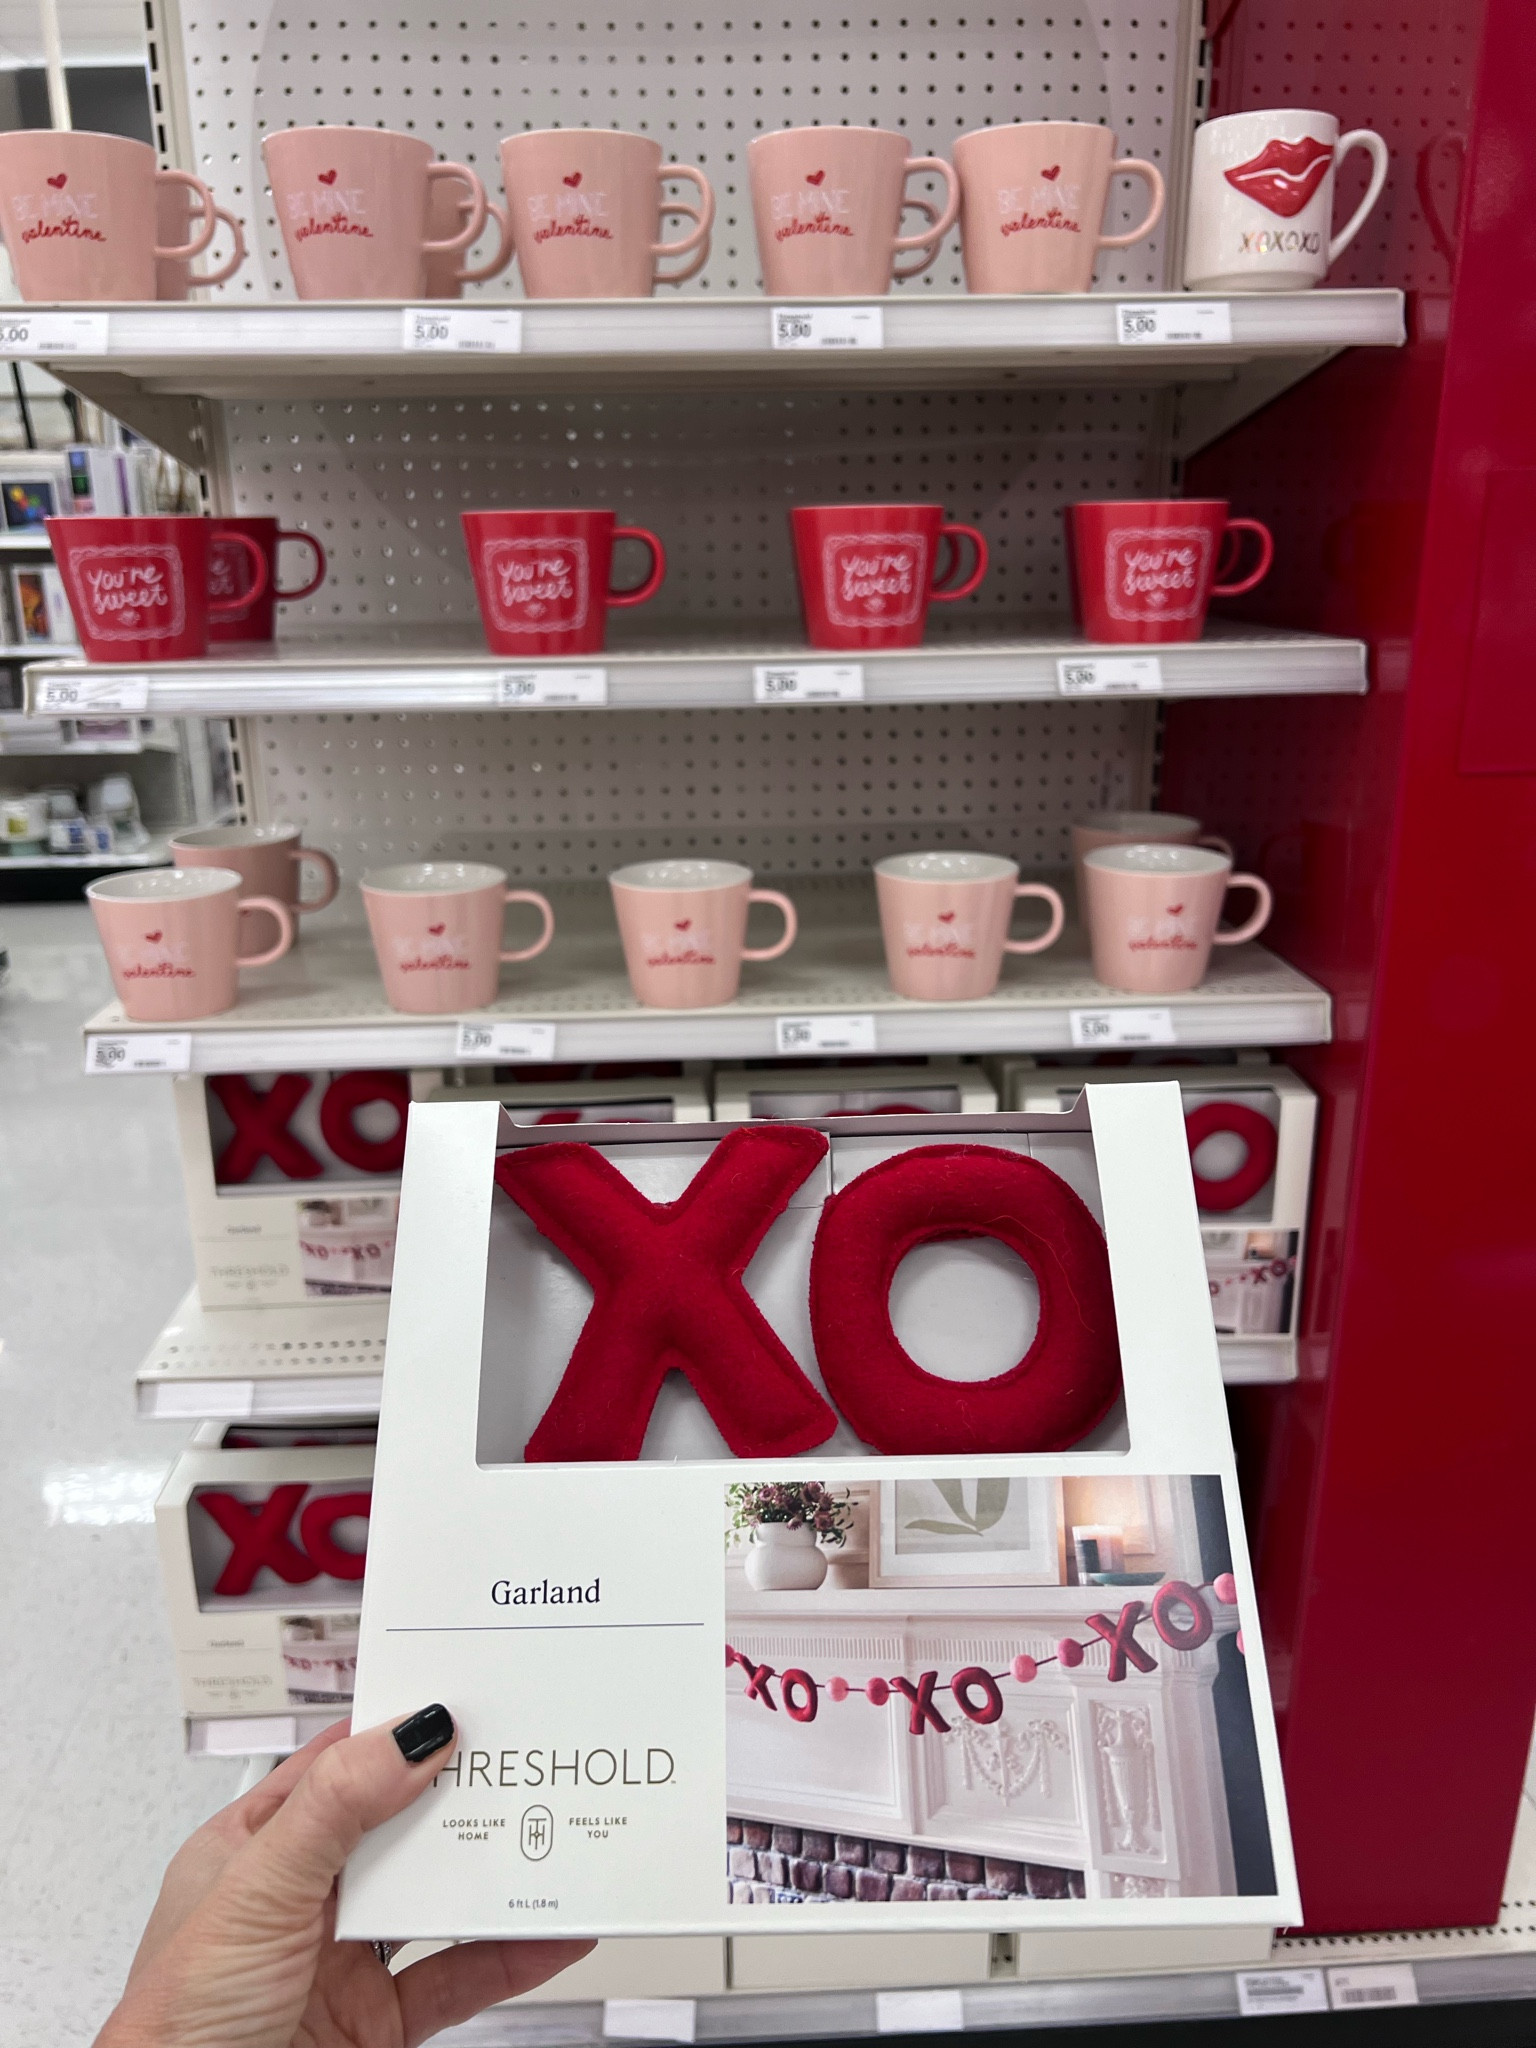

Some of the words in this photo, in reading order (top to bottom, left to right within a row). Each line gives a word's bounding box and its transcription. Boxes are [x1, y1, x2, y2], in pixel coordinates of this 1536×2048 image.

[1237, 230, 1321, 255] XOXOXO
[414, 325, 449, 339] 5.00
[778, 323, 812, 338] 5.00
[1124, 319, 1156, 333] 5.00
[494, 1125, 1123, 1463] XO
[490, 1577, 602, 1606] Garland
[890, 1666, 1004, 1735] XO
[1084, 1580, 1213, 1682] XO
[432, 1747, 675, 1788] HRESHOLD
[442, 1818, 479, 1829] LOOKS
[482, 1818, 507, 1828] LIKE
[568, 1817, 601, 1827] FEELS
[603, 1816, 629, 1826] LIKE
[457, 1831, 490, 1841] HOME
[586, 1829, 610, 1839] YOU
[508, 1899, 515, 1909] 6
[516, 1899, 524, 1908] ft
[525, 1899, 531, 1908] L
[547, 1899, 559, 1909] m)
